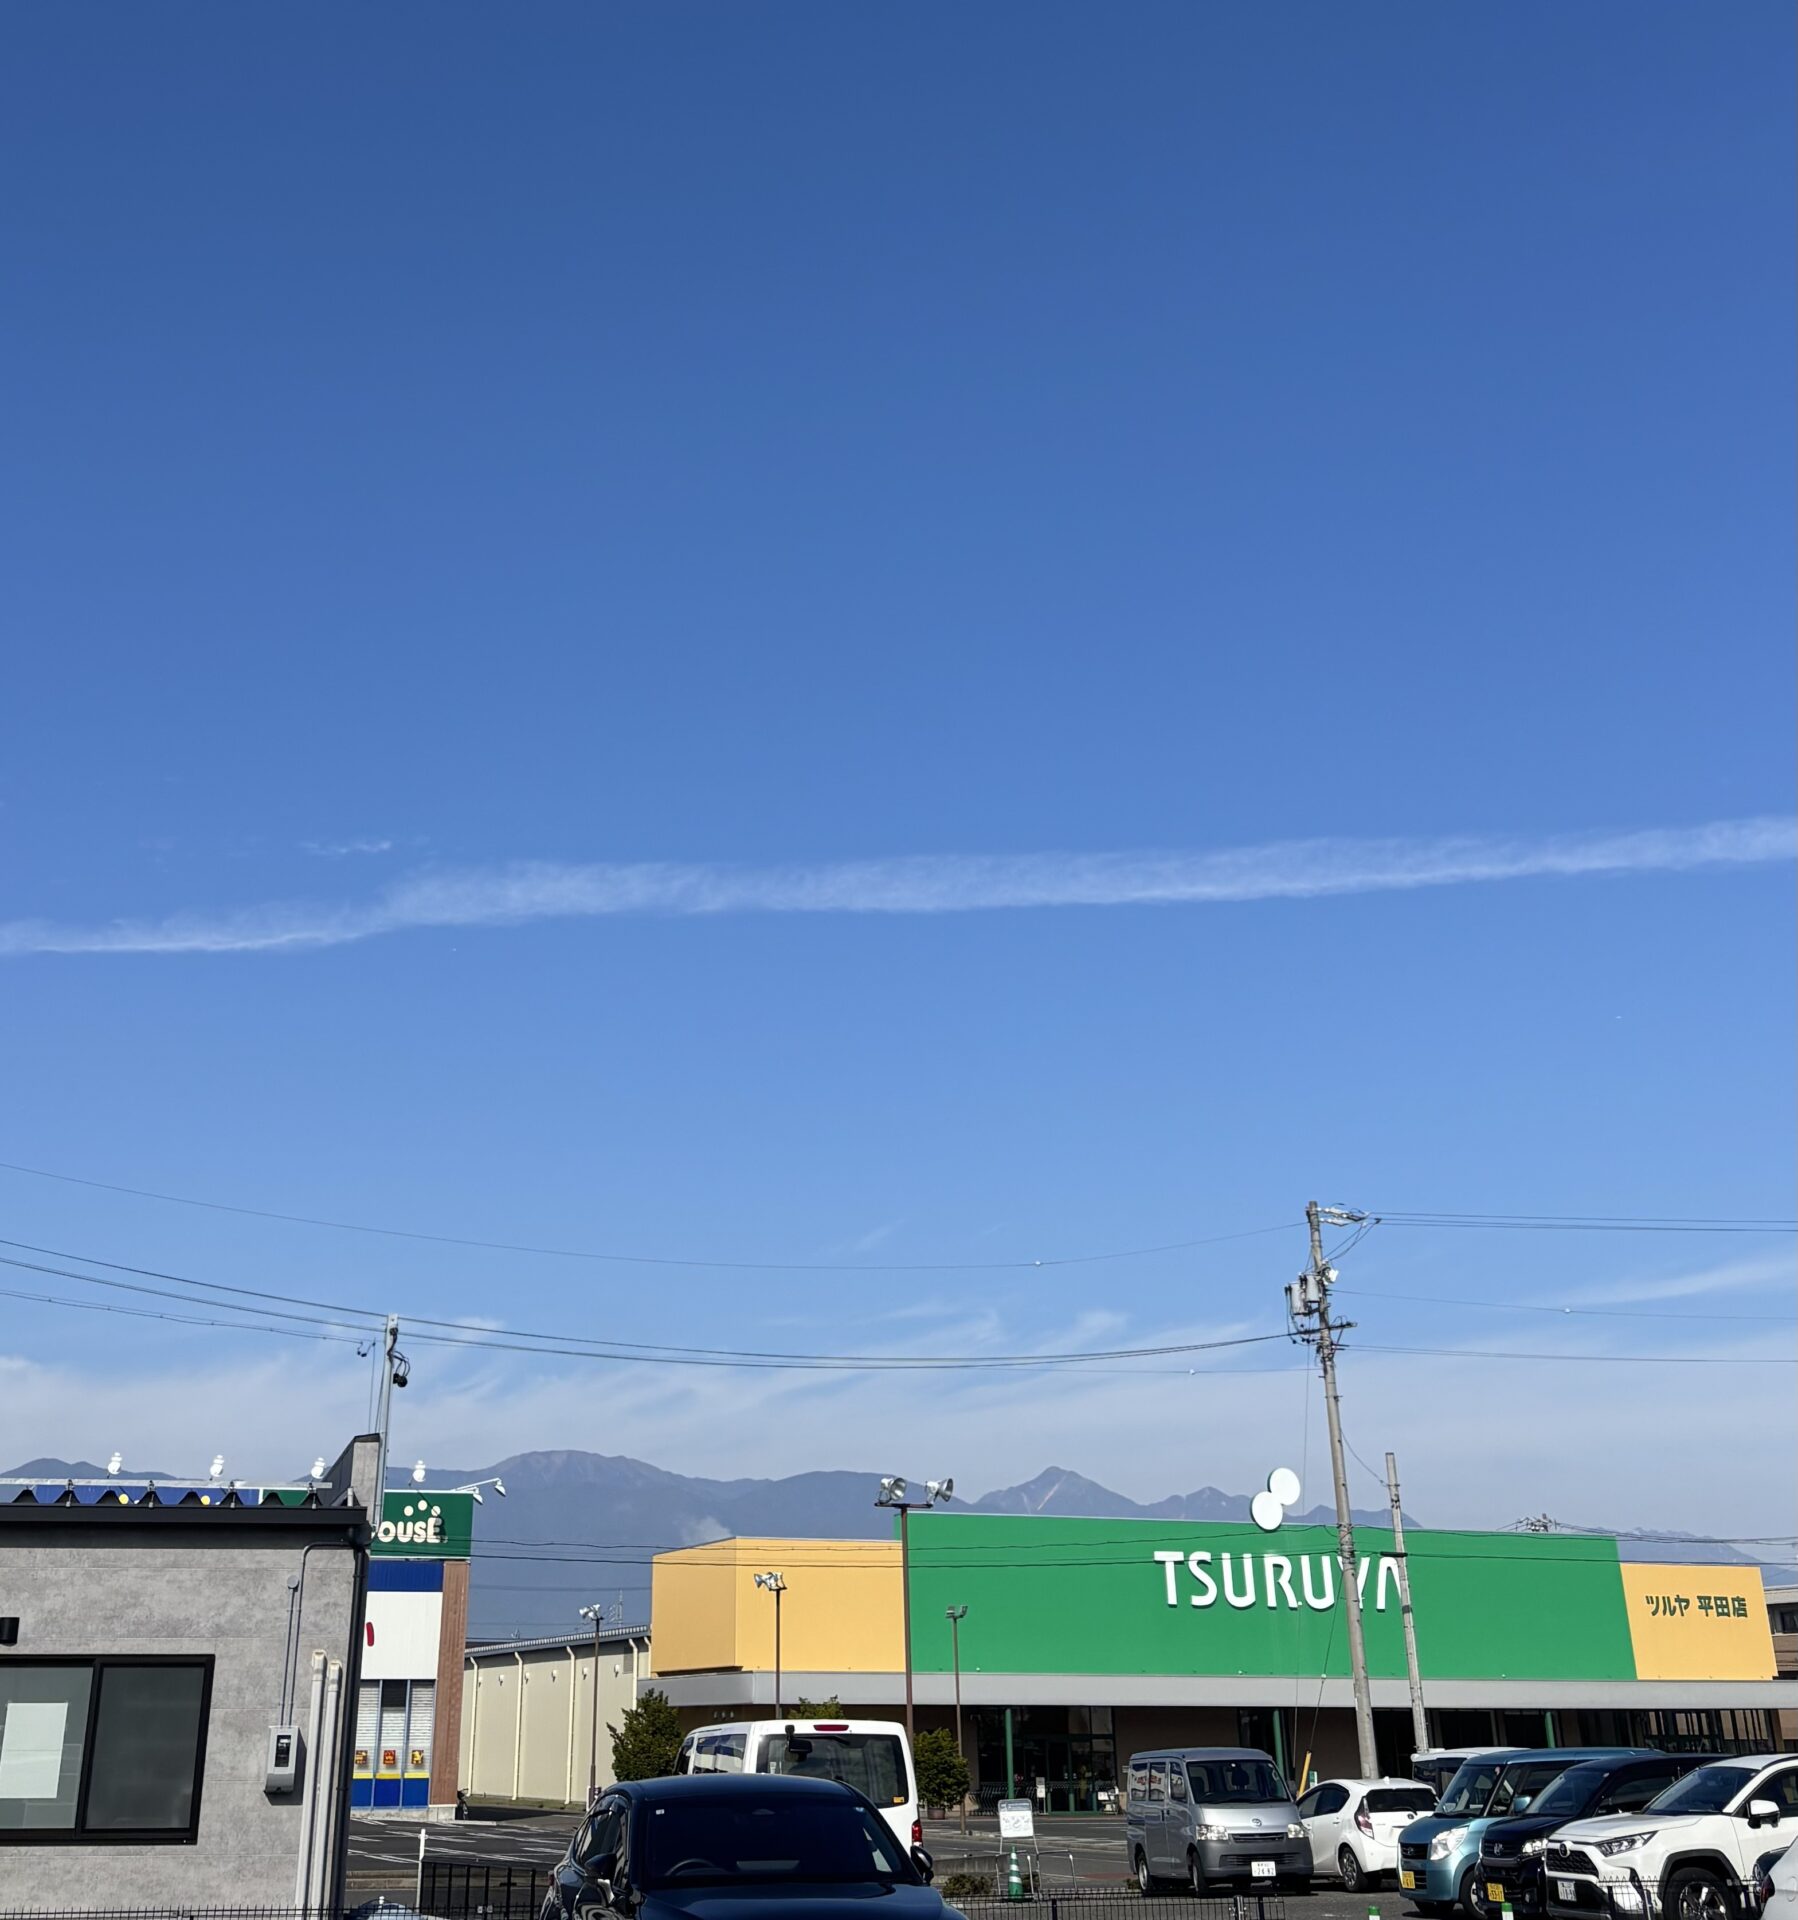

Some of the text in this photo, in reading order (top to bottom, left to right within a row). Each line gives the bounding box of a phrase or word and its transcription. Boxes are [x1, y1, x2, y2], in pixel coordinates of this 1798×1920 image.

[371, 1517, 443, 1543] OUSE
[1645, 1594, 1748, 1618] ツルヤ 平田店
